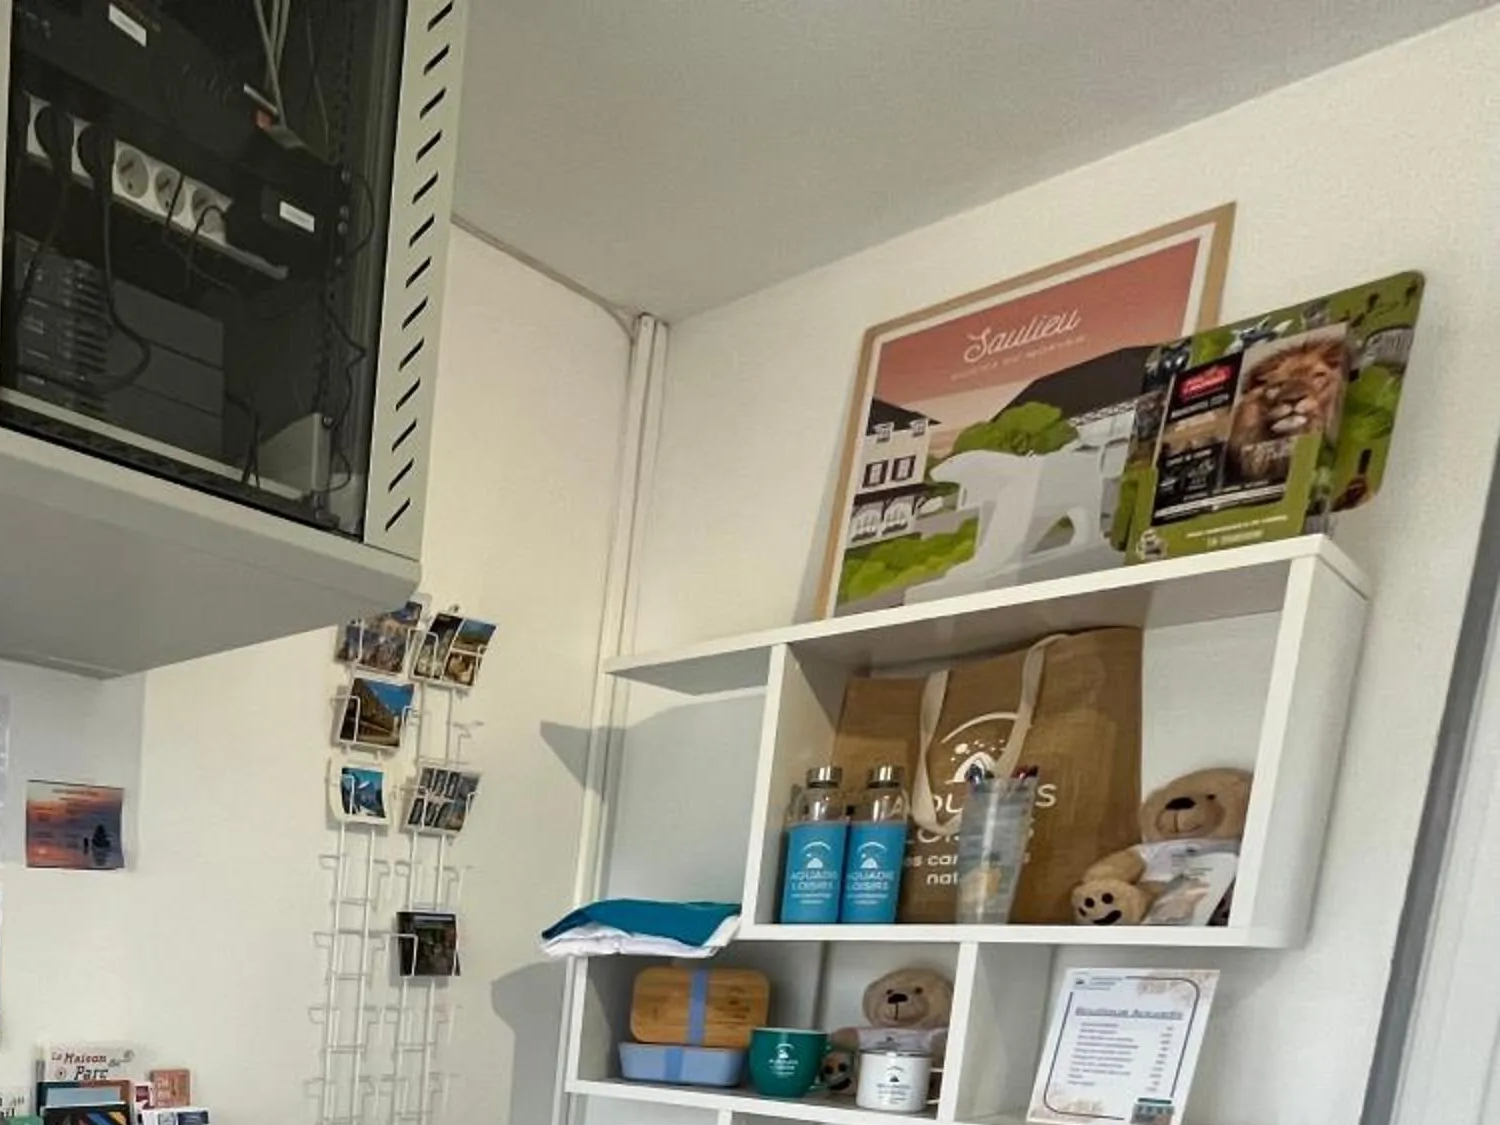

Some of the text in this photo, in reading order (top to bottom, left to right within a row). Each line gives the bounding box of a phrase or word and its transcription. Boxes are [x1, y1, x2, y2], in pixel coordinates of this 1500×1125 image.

[963, 307, 1082, 363] Saulieu
[63, 1052, 108, 1065] Maison
[73, 1065, 109, 1081] Parc
